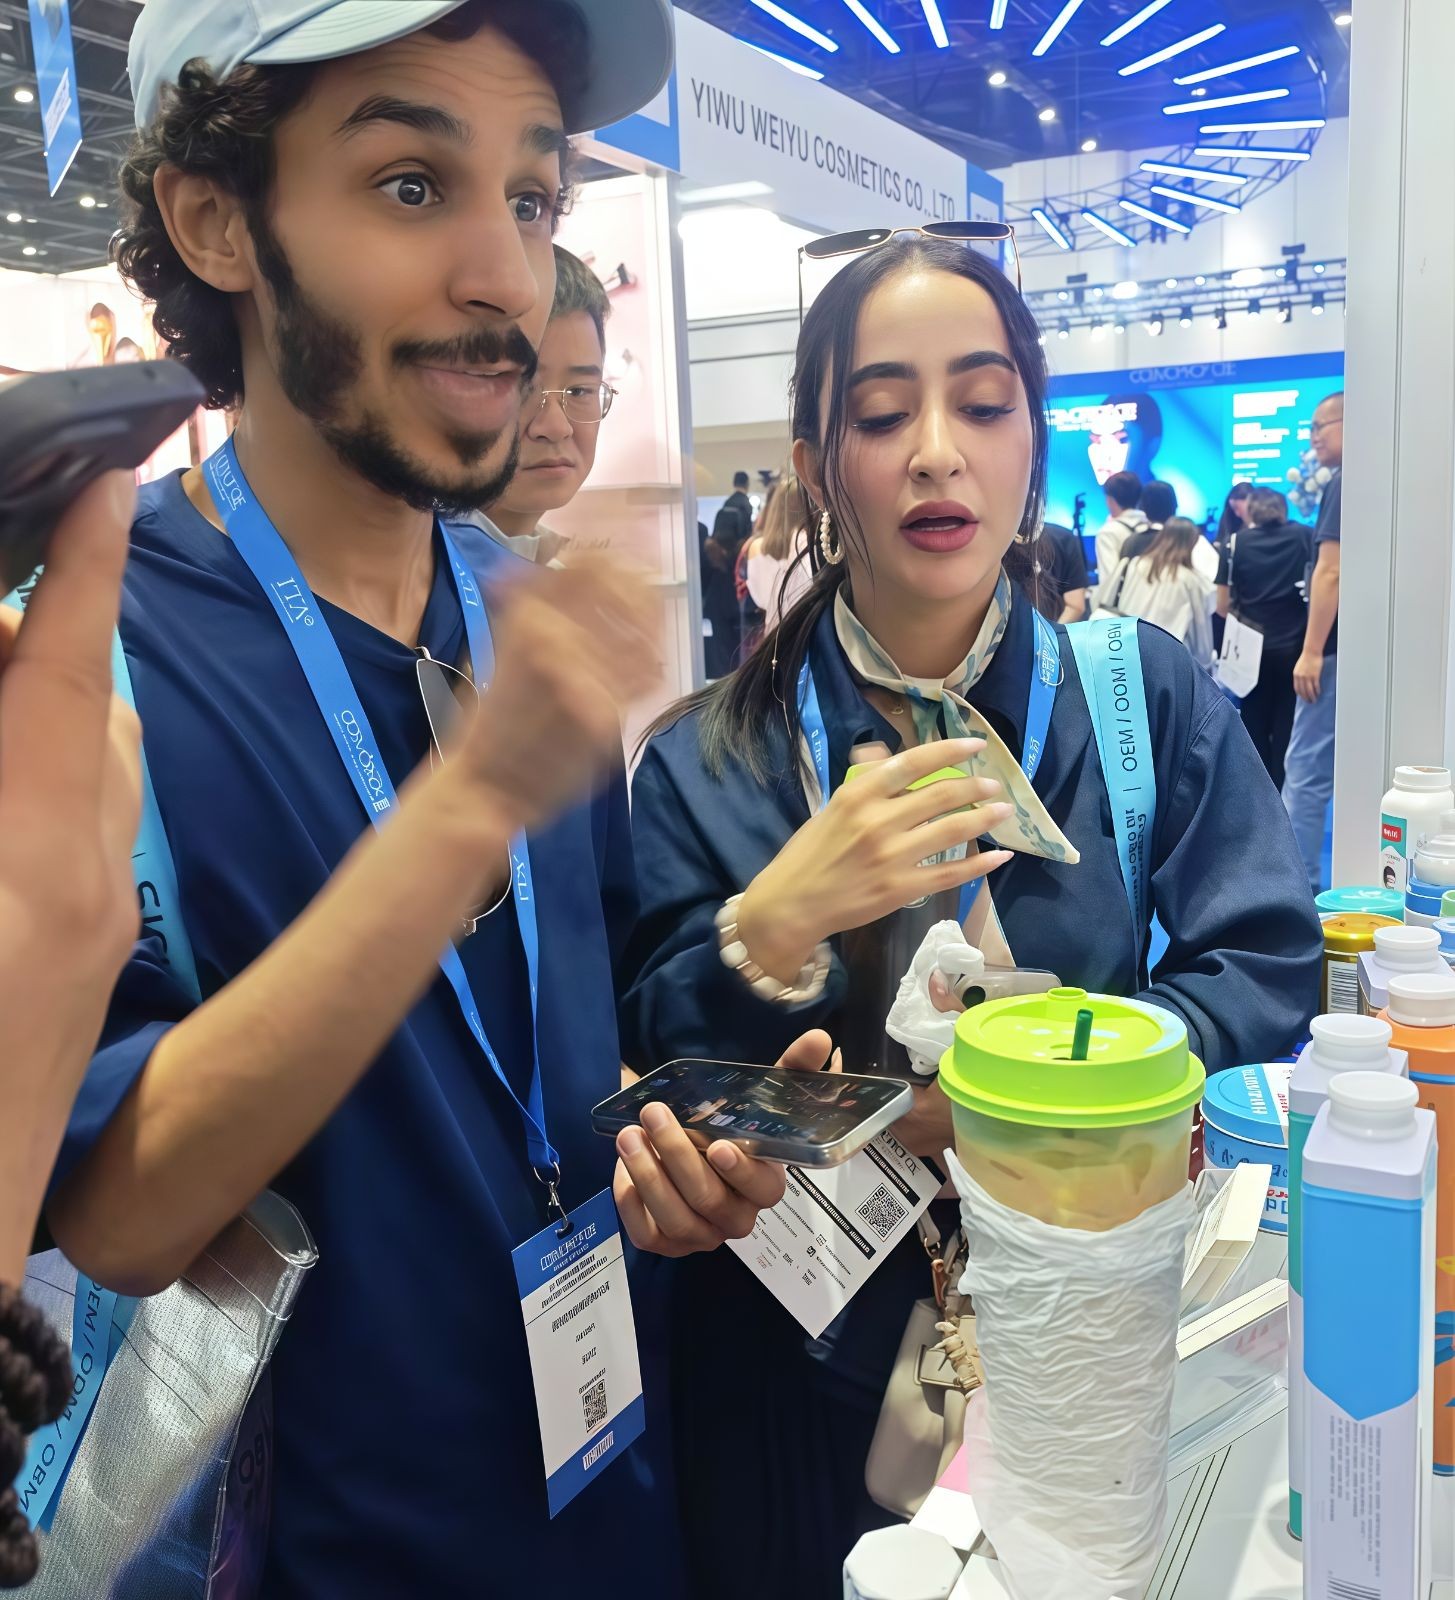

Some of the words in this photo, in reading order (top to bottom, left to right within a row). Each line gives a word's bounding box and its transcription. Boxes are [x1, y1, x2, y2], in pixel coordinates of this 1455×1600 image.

[691, 77, 745, 135] YIWU
[751, 104, 808, 162] WEIYU
[814, 136, 901, 202] COSMETICS
[1119, 729, 1137, 772] OEM
[20, 1443, 55, 1512] OBM
